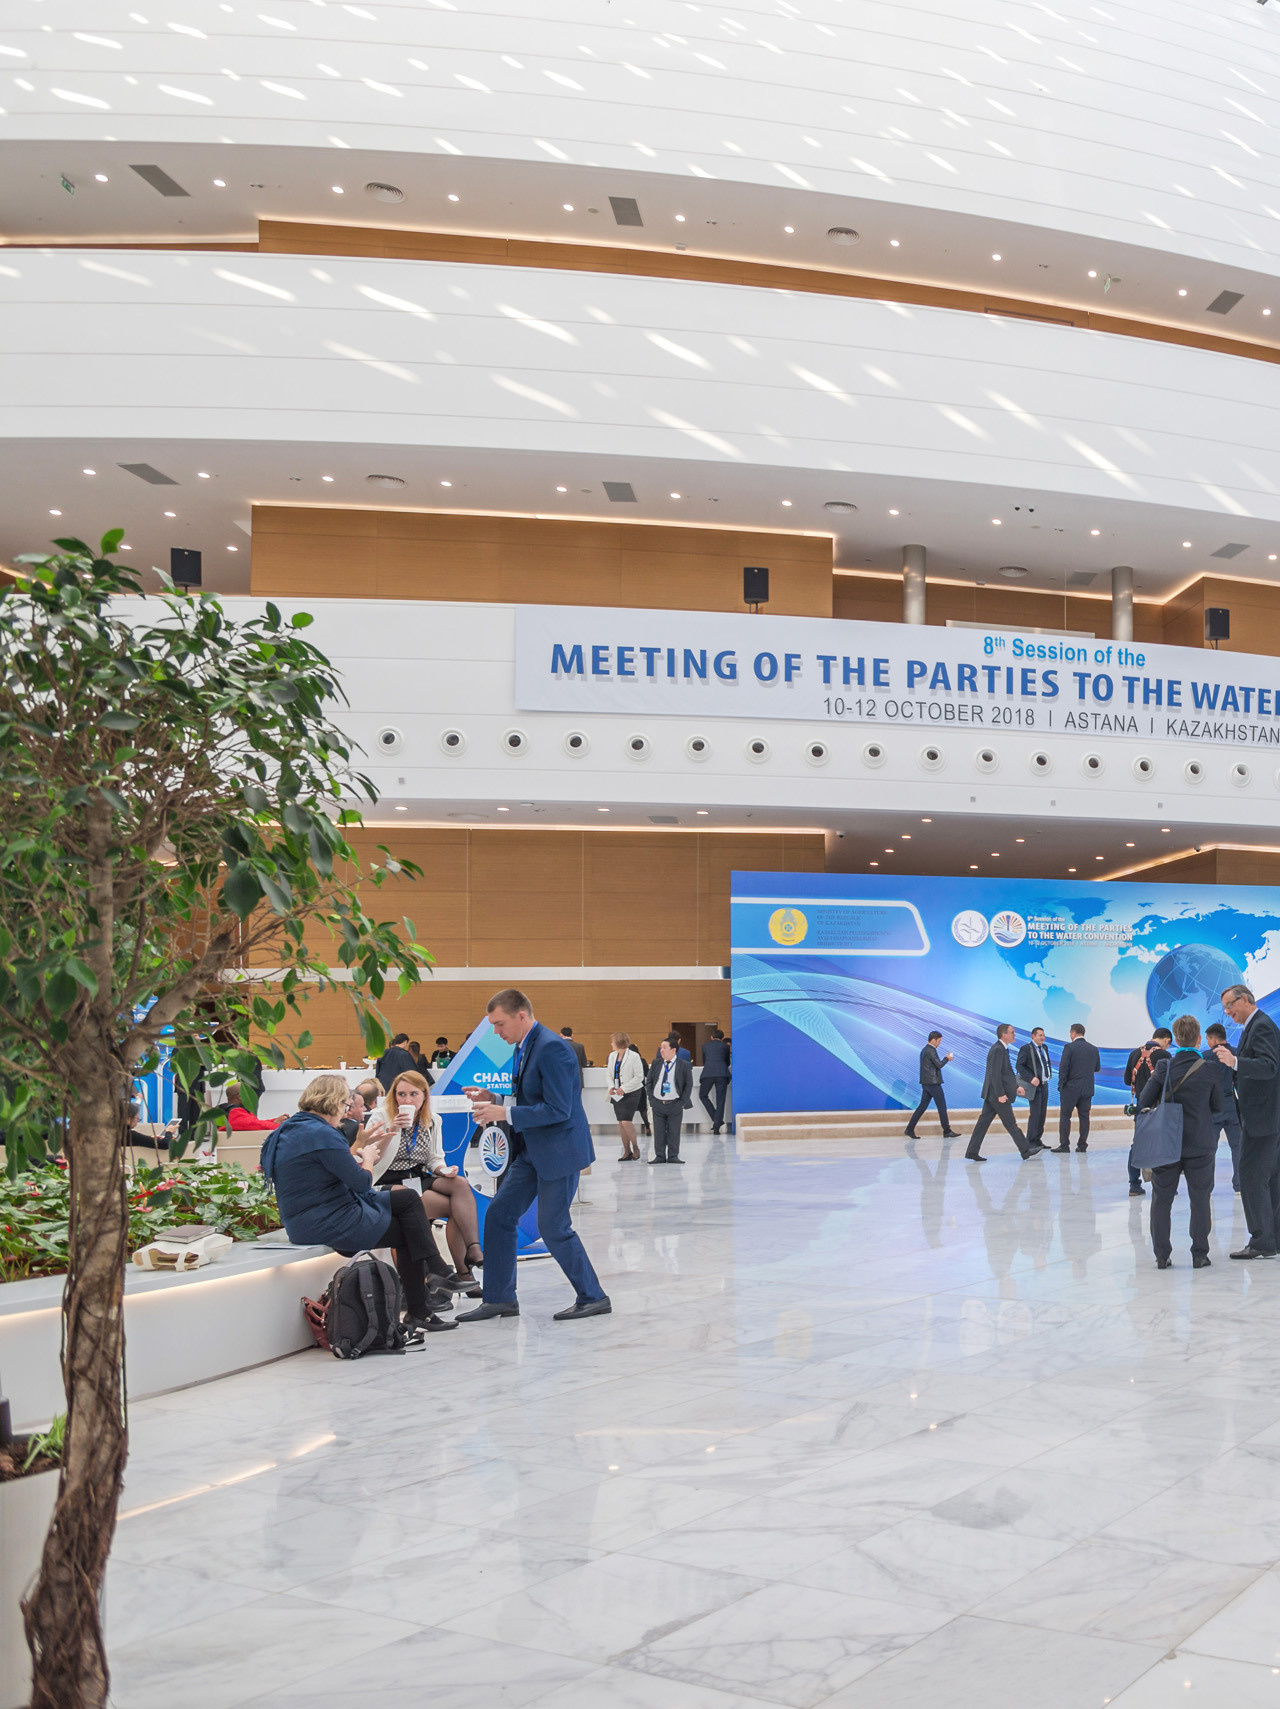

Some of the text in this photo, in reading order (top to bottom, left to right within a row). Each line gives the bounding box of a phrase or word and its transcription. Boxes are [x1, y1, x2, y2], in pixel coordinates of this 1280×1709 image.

[983, 636, 1145, 667] 8th Session of the
[551, 643, 737, 680] MEETING
[753, 652, 801, 682] OF
[816, 655, 890, 687] THE
[907, 660, 1059, 697] PARTIES
[1073, 671, 1113, 702] TO
[1122, 676, 1182, 707] THE
[824, 697, 876, 717] 10-12
[884, 700, 984, 723] OCTOBER
[991, 706, 1035, 726] 2018
[1064, 711, 1139, 733] ASTANA
[1167, 718, 1280, 744] KAZAKHSTAN
[1027, 923, 1066, 931] MEETING
[1099, 924, 1133, 932] PARTIES
[1084, 933, 1133, 941] CONVENTION
